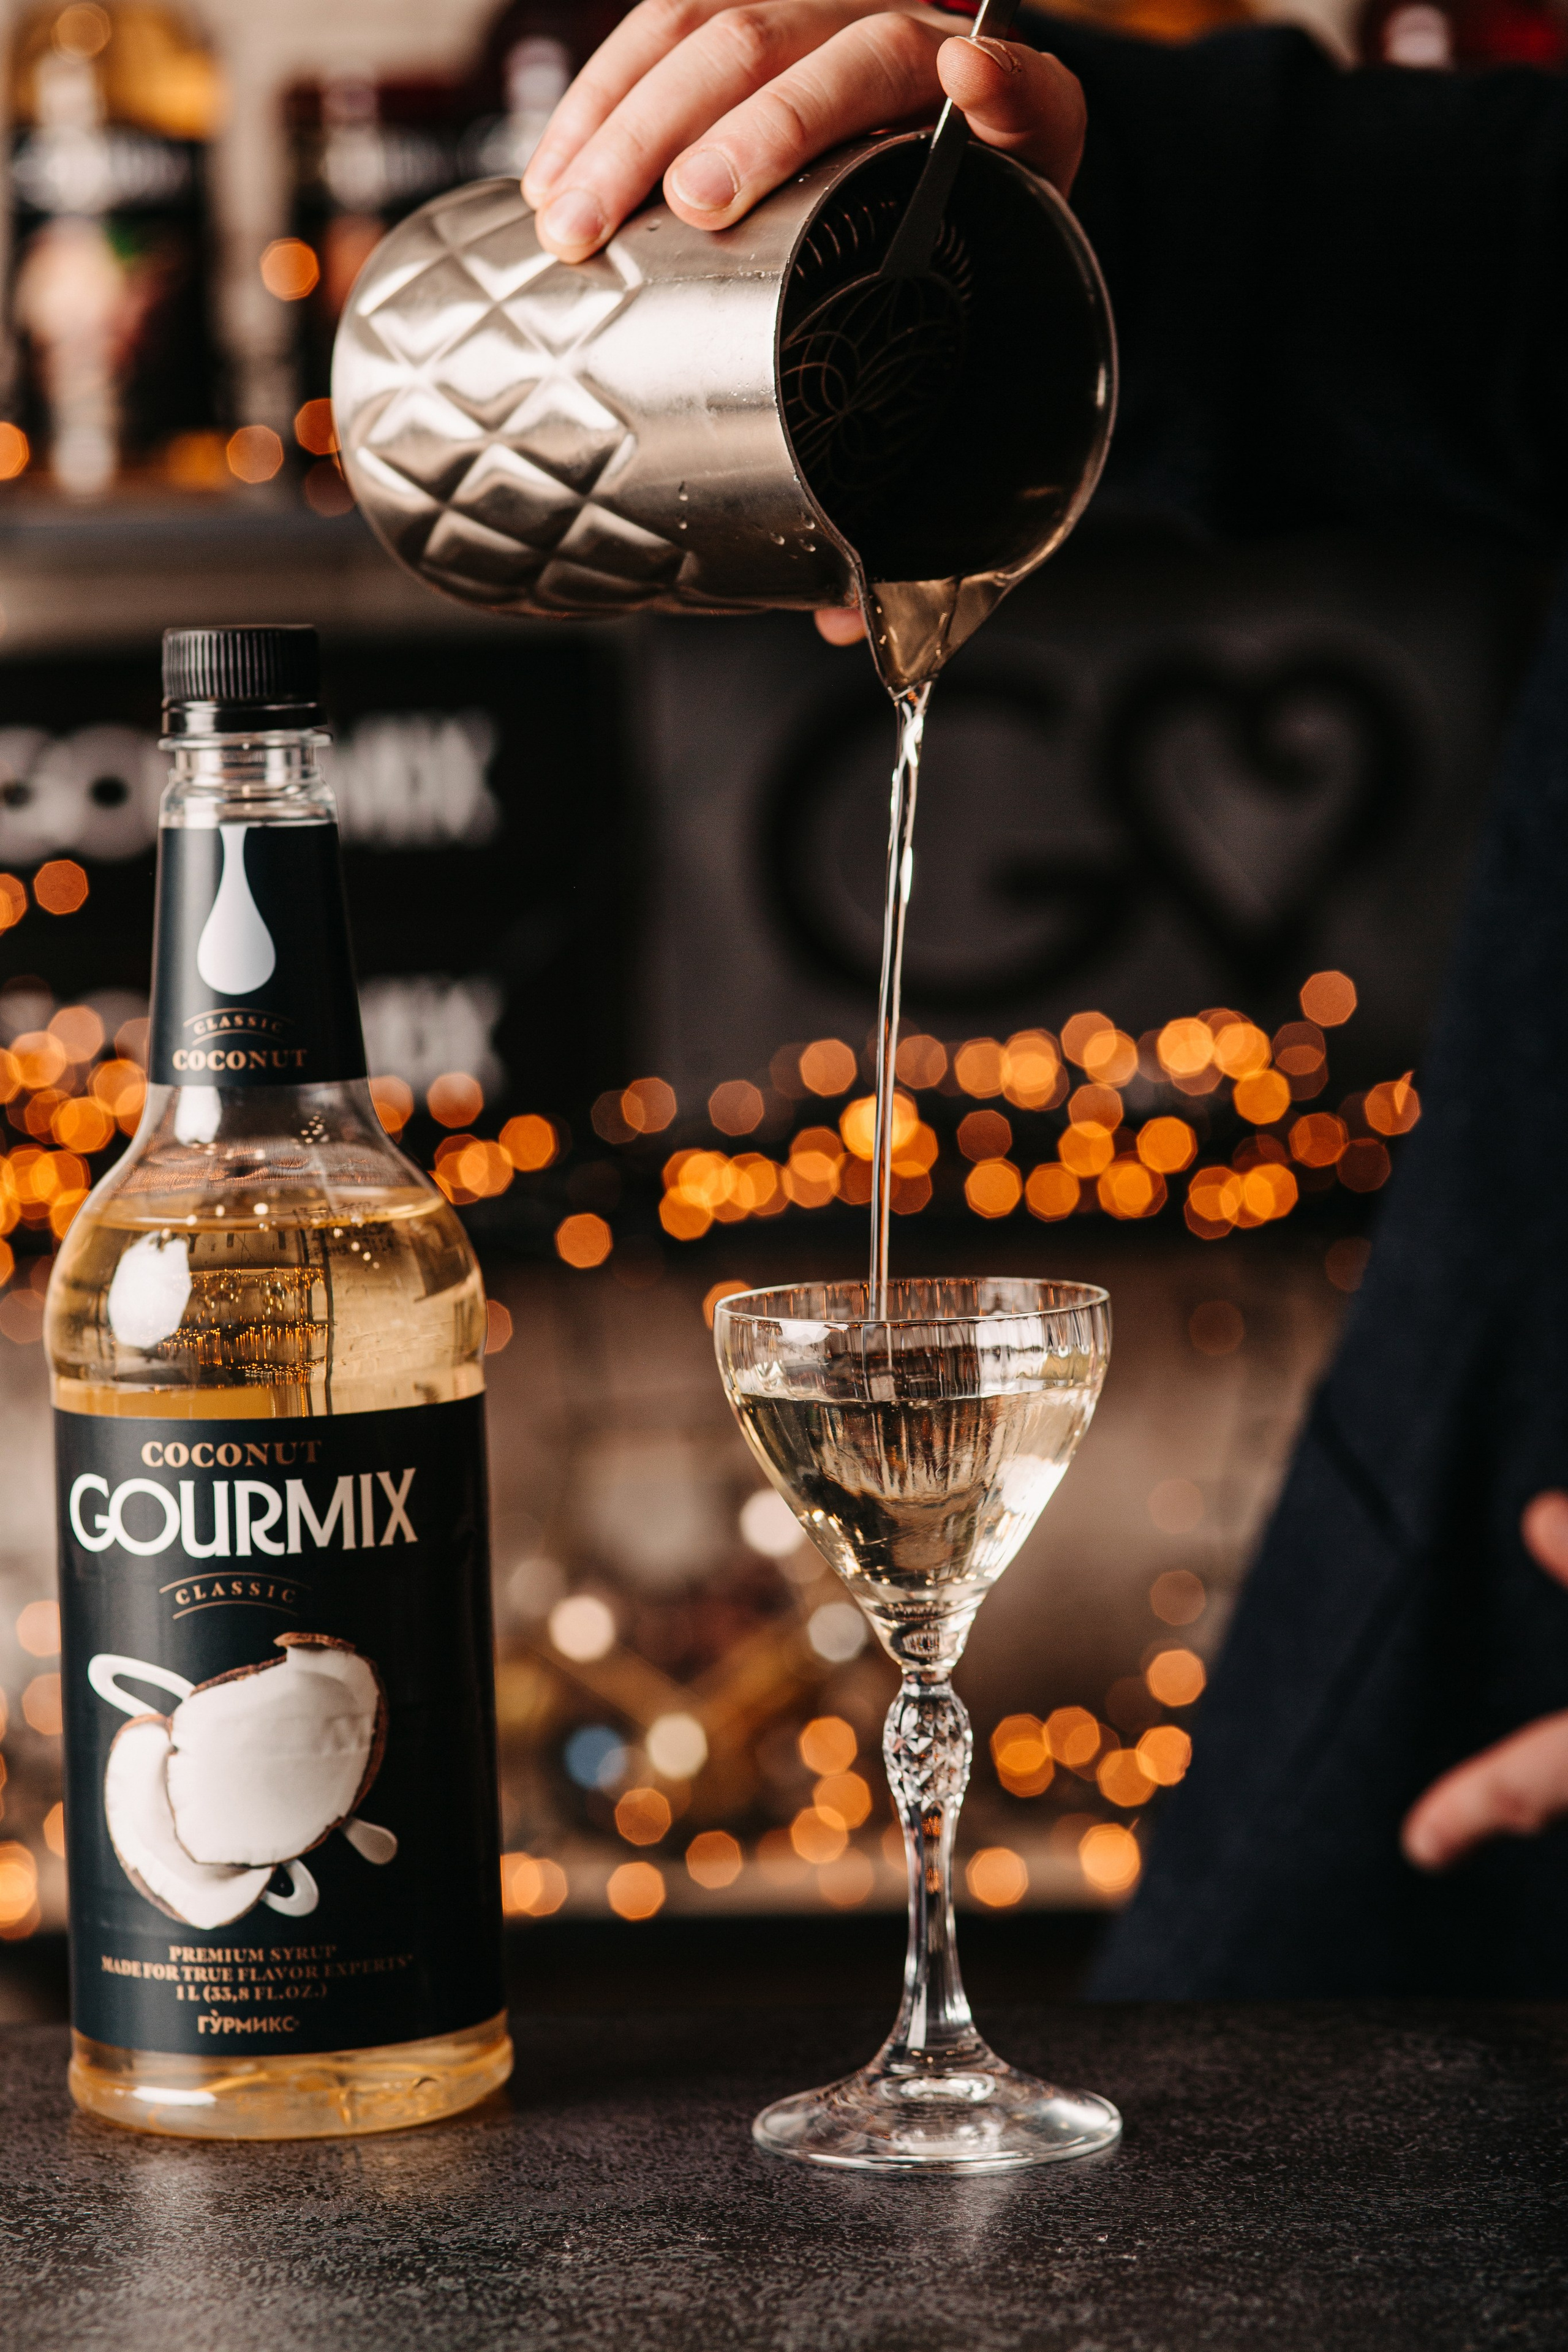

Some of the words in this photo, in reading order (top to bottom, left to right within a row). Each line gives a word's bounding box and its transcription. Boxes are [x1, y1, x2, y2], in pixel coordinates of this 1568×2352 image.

[194, 1014, 284, 1035] CLASSIC
[172, 1048, 307, 1071] COCONUT
[141, 1441, 322, 1468] COCONUT
[69, 1468, 419, 1559] GOURMIX
[175, 1581, 298, 1605] CLASSIC
[169, 1945, 265, 1963] PREMIUM
[270, 1944, 336, 1962] SYRUP
[101, 1954, 142, 1978] MADE
[143, 1962, 180, 1982] FOR
[181, 1965, 234, 1983] TRUE
[237, 1966, 319, 1983] FLAVOR
